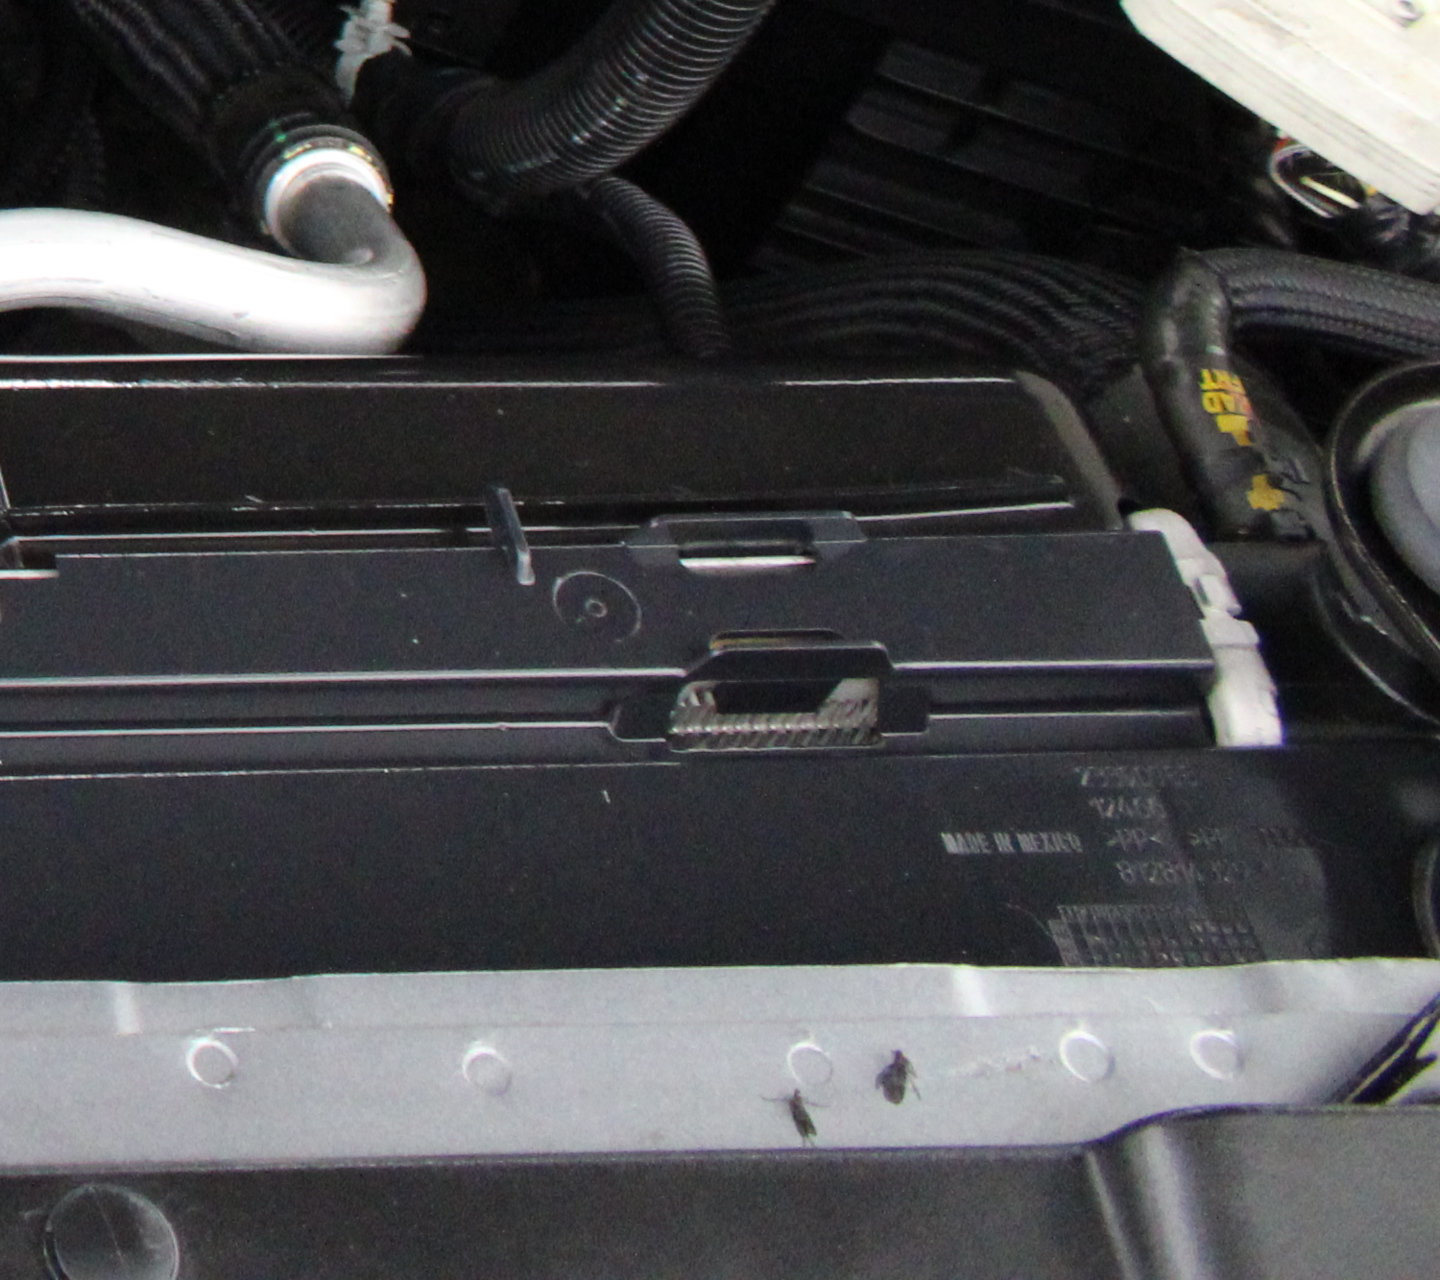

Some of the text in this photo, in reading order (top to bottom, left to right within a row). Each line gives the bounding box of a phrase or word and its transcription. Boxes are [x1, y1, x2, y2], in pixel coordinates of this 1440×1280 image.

[940, 831, 1084, 854] MADE IN MEXICO
